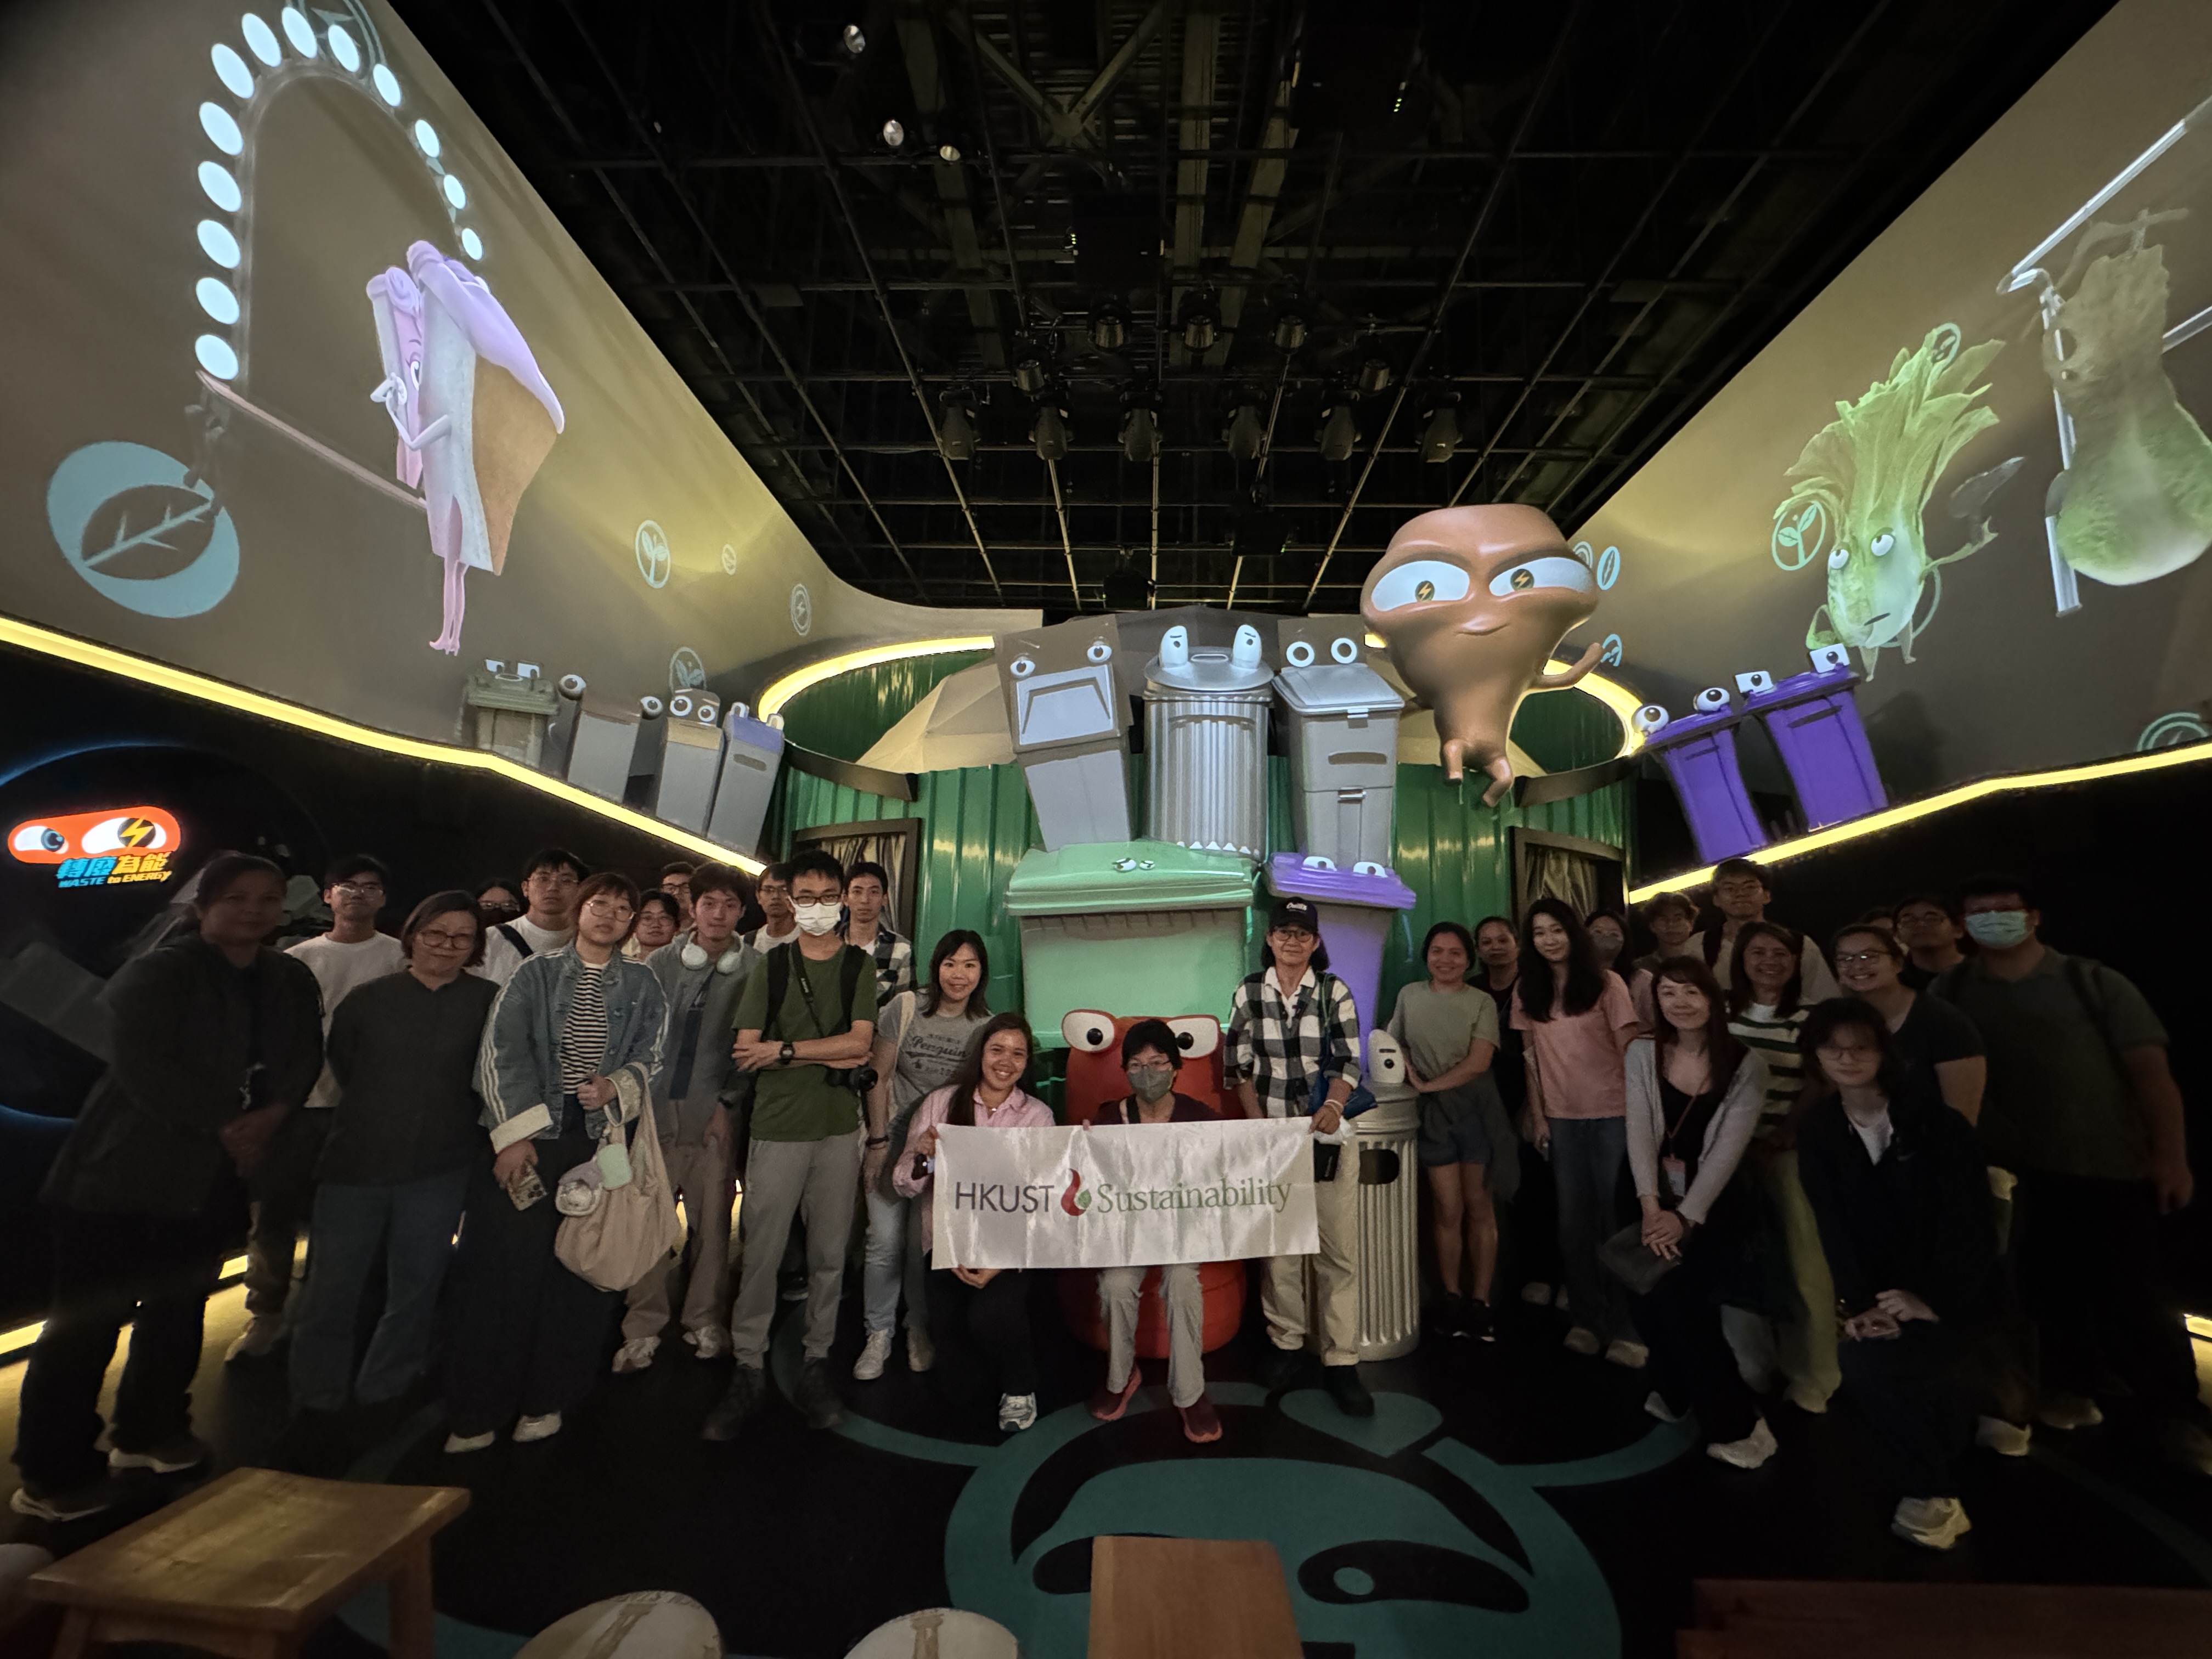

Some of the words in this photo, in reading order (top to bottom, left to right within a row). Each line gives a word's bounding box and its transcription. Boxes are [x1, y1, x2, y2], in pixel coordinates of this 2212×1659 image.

[58, 877, 106, 888] WASTE
[122, 871, 172, 882] ENERGY
[911, 1036, 967, 1058] Penguin
[955, 1182, 1054, 1213] HKUST
[1097, 1177, 1292, 1214] Sustainability
